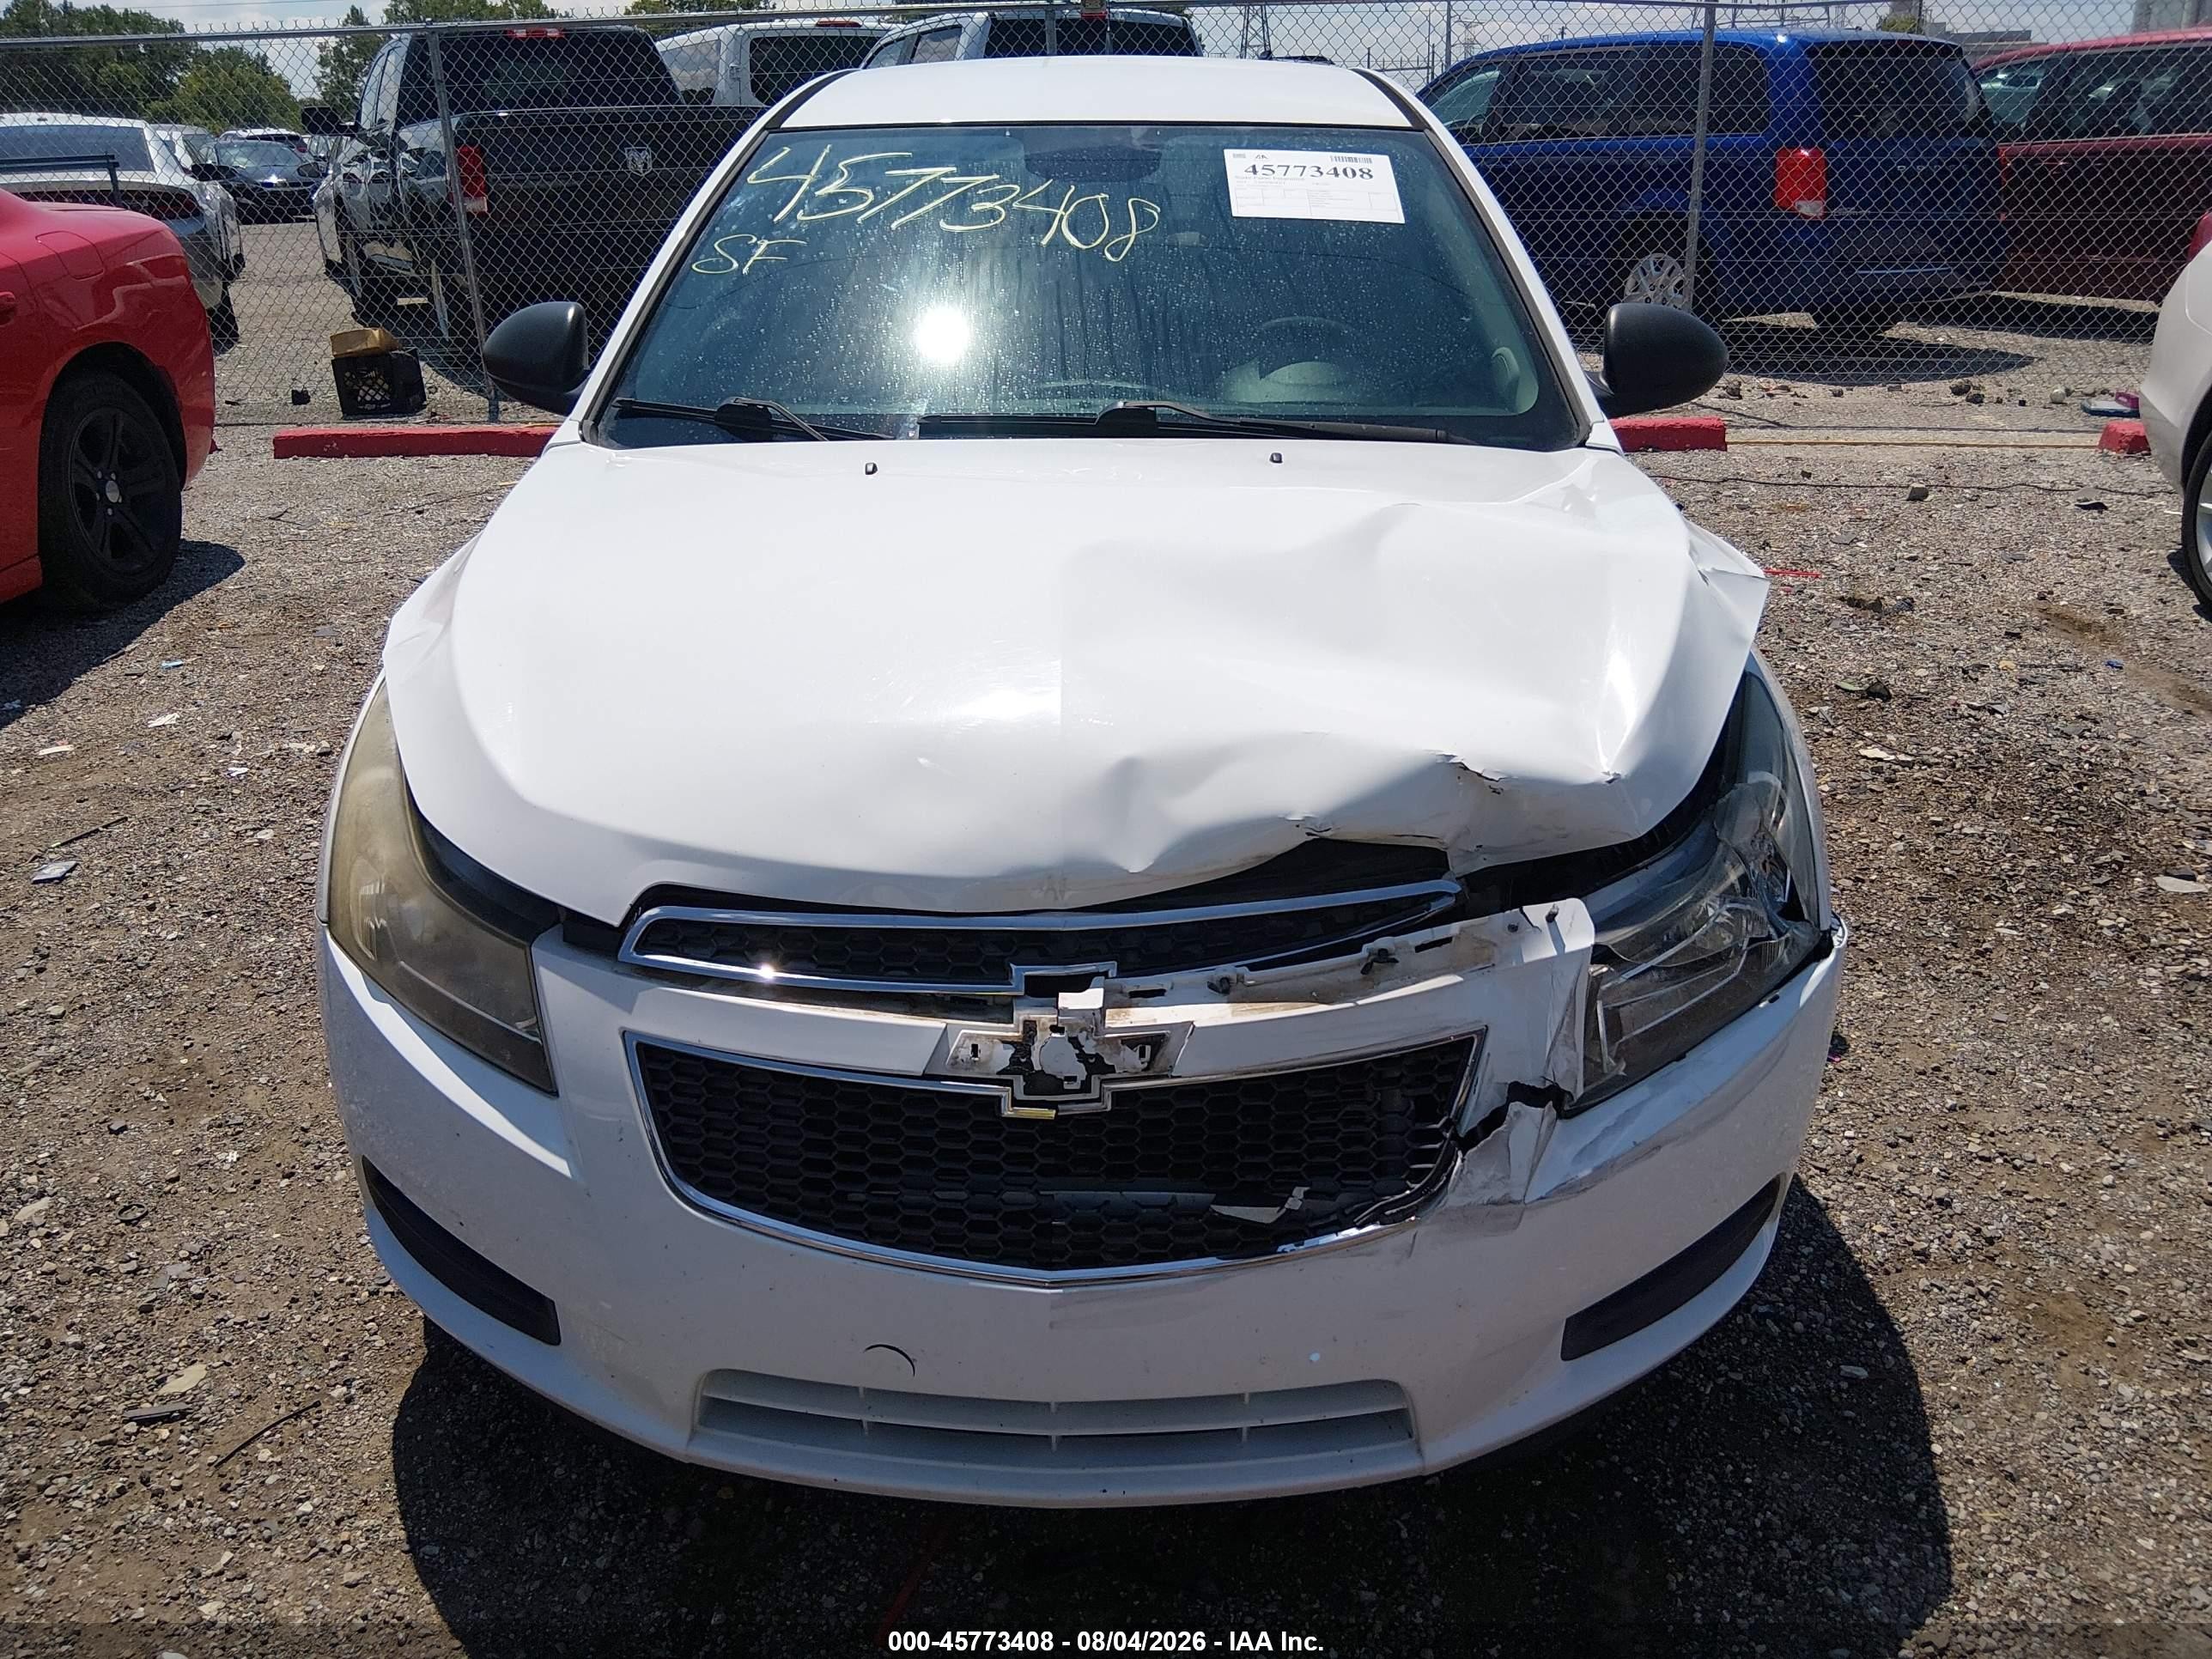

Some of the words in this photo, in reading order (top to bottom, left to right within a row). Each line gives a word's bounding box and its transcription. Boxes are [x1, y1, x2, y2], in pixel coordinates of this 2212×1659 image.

[1244, 163, 1374, 180] 45773408
[746, 143, 1161, 262] 45773408
[691, 234, 807, 276] SF
